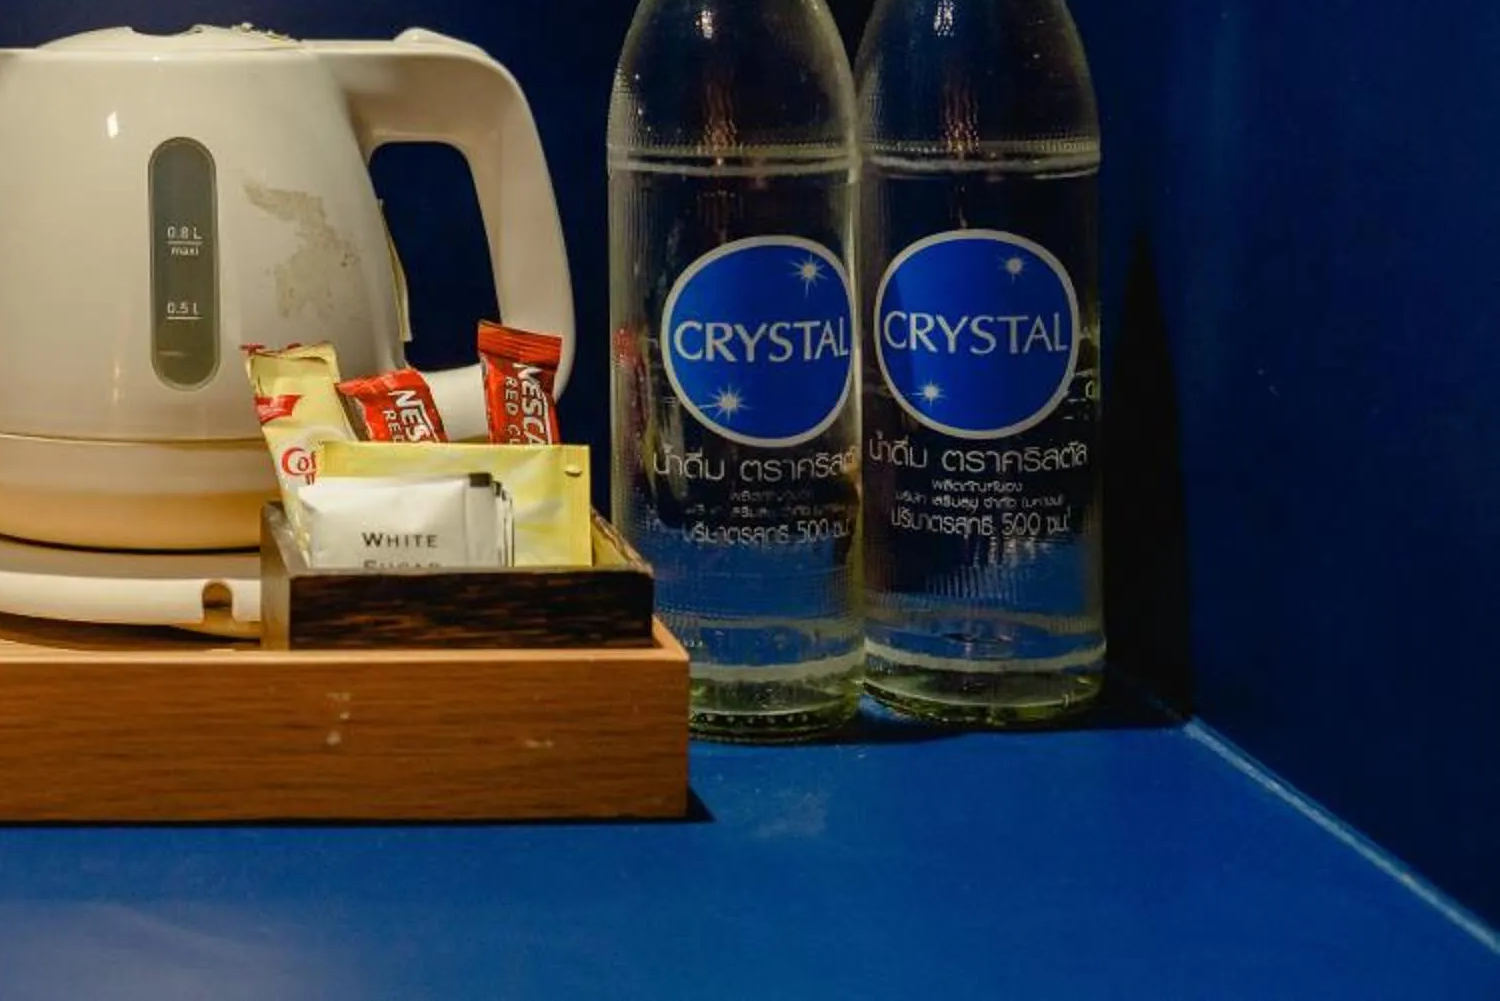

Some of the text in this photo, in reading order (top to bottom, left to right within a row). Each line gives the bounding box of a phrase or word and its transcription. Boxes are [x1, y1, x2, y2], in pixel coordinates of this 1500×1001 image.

[166, 226, 202, 240] 0.8 L
[171, 245, 199, 256] maxi
[166, 302, 189, 314] 0.5
[674, 317, 850, 363] CRYSTAL
[882, 311, 1068, 355] CRYSTAL
[505, 376, 519, 416] RED
[512, 362, 547, 445] NESCA
[653, 445, 725, 481] น้ำดื่ม
[868, 431, 1088, 474] น้ำดื่ม ตราคริสตัล
[796, 518, 829, 544] 500
[1001, 511, 1041, 536] 500
[361, 532, 439, 548] WHITE
